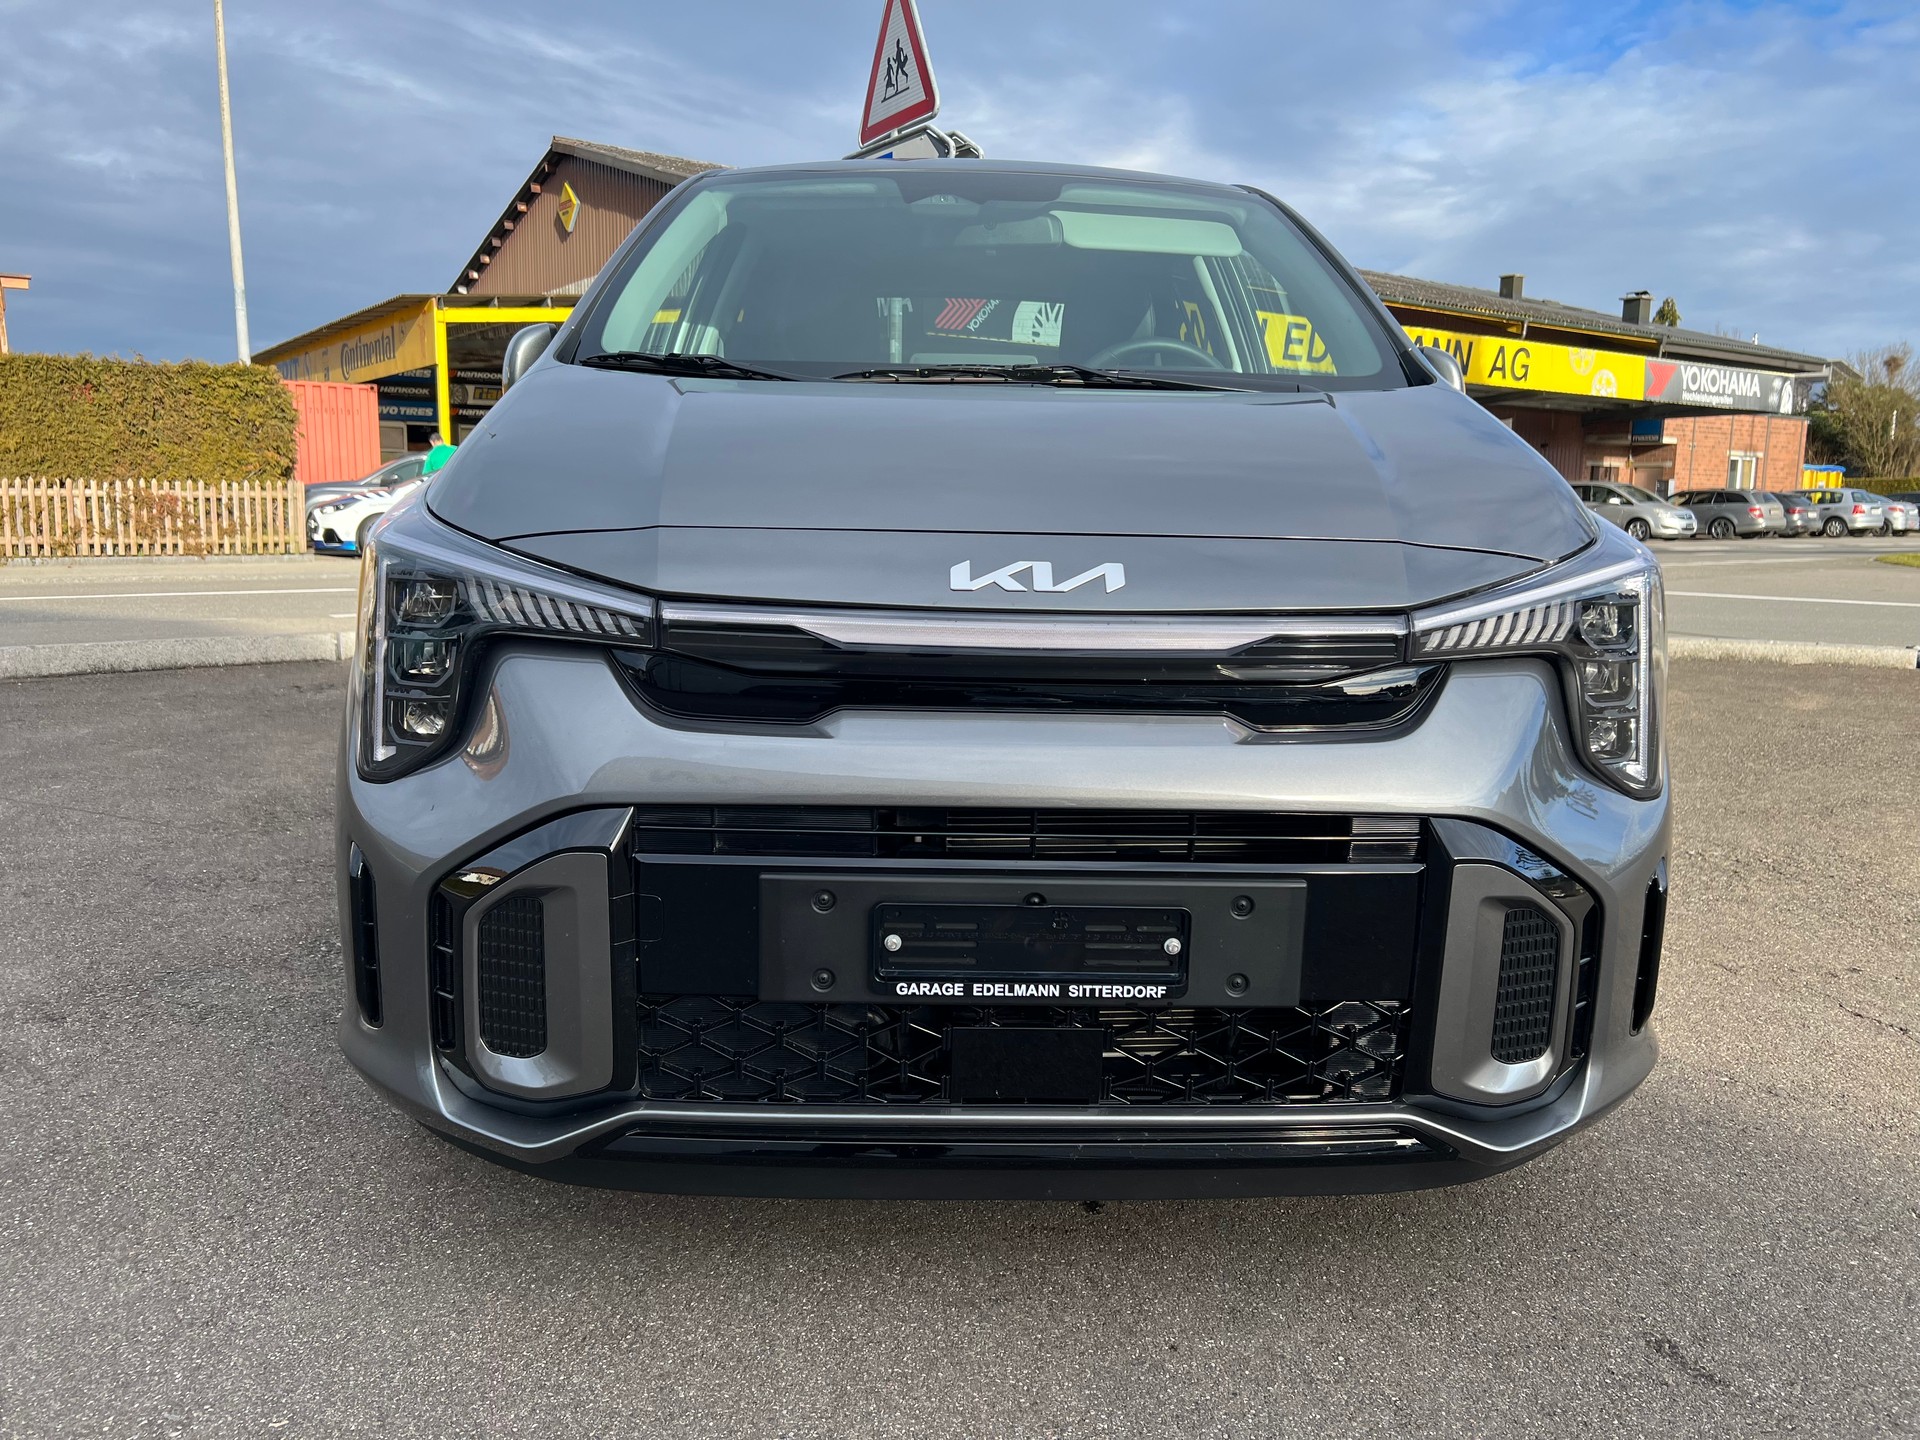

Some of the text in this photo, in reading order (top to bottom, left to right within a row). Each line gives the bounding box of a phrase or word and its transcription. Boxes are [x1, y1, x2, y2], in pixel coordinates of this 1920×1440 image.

[966, 299, 1001, 332] YOKOHAM
[341, 325, 396, 380] Continental
[1487, 345, 1531, 382] AG
[1680, 364, 1761, 398] YOKOHAMA
[400, 407, 434, 417] TIRES
[950, 560, 1126, 594] KIA
[896, 983, 1167, 999] GARAGE EDELMANN SITTERDORF
